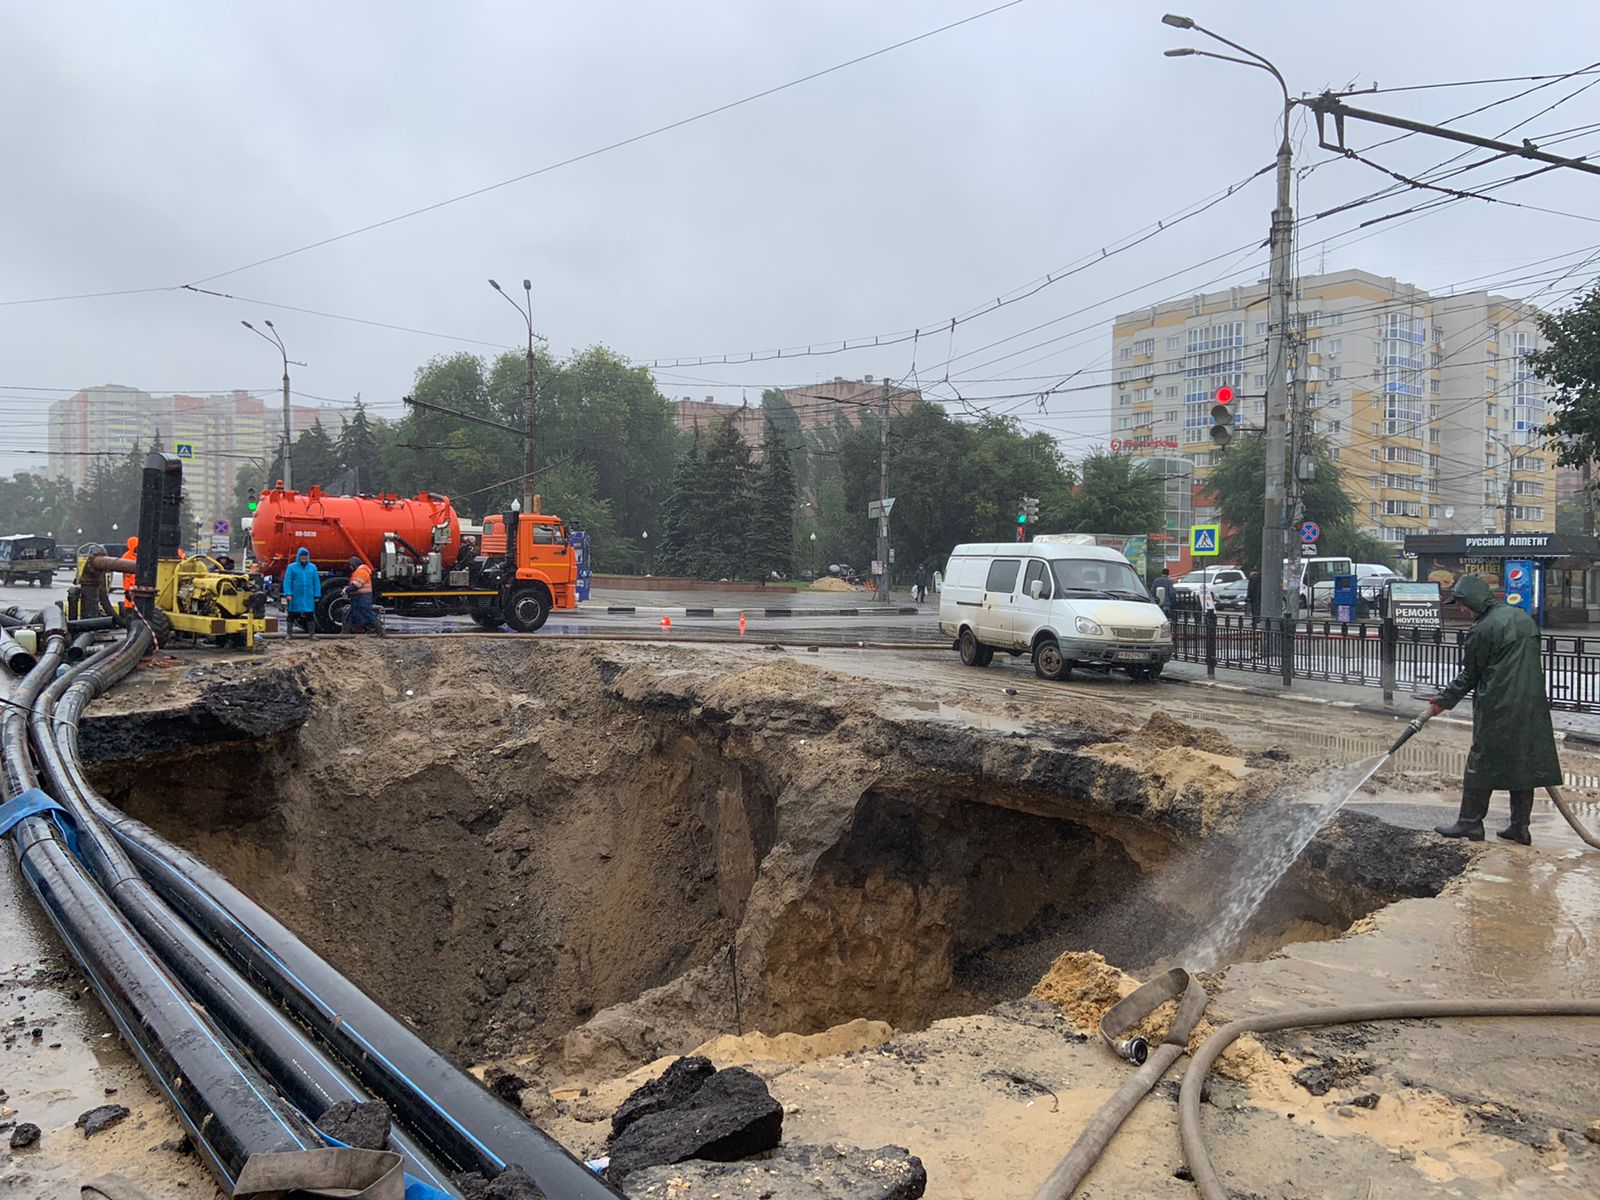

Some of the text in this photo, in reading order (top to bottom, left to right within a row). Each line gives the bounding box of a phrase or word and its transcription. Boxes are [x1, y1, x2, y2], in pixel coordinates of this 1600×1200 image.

[1466, 536, 1548, 546] РУССКИЙ АППЕТИТ
[1395, 608, 1439, 617] РЕМОНТ
